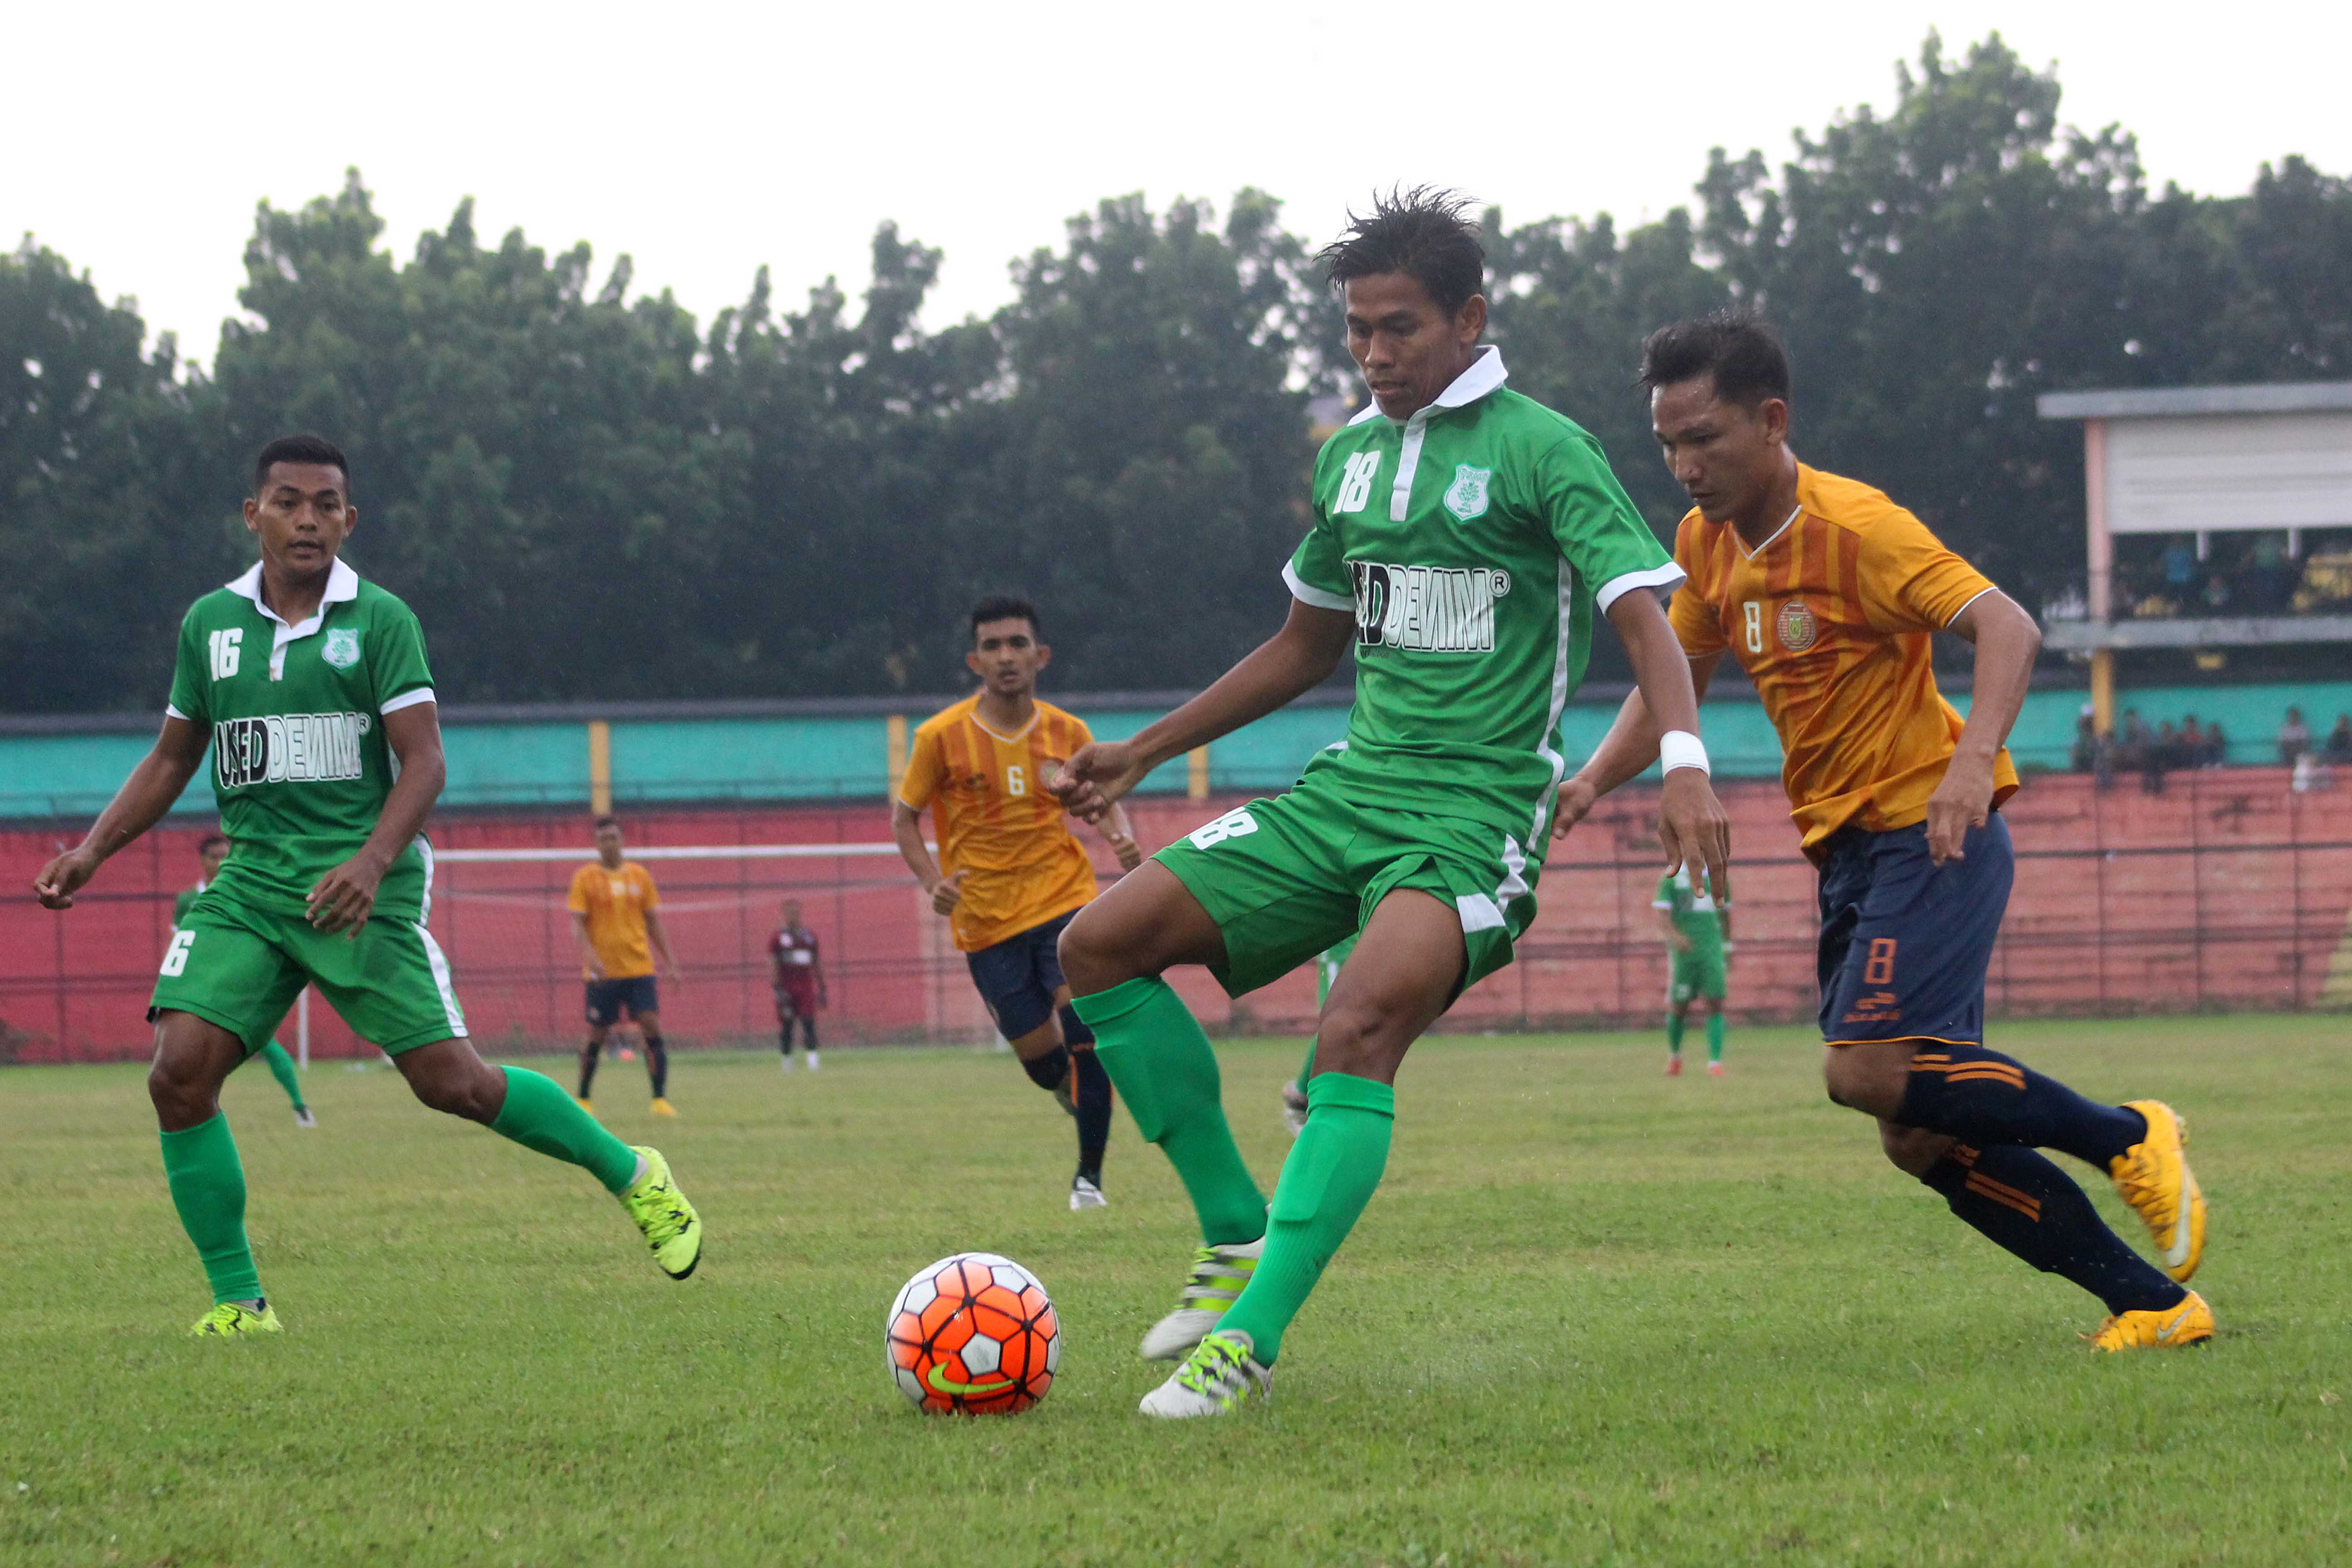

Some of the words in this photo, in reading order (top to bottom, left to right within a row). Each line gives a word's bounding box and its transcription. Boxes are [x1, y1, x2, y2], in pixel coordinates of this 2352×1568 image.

[1333, 451, 1380, 514] 18
[1743, 601, 1762, 653] 8
[208, 627, 244, 682] 16
[1007, 765, 1025, 796] 6
[1864, 938, 1897, 985] 8
